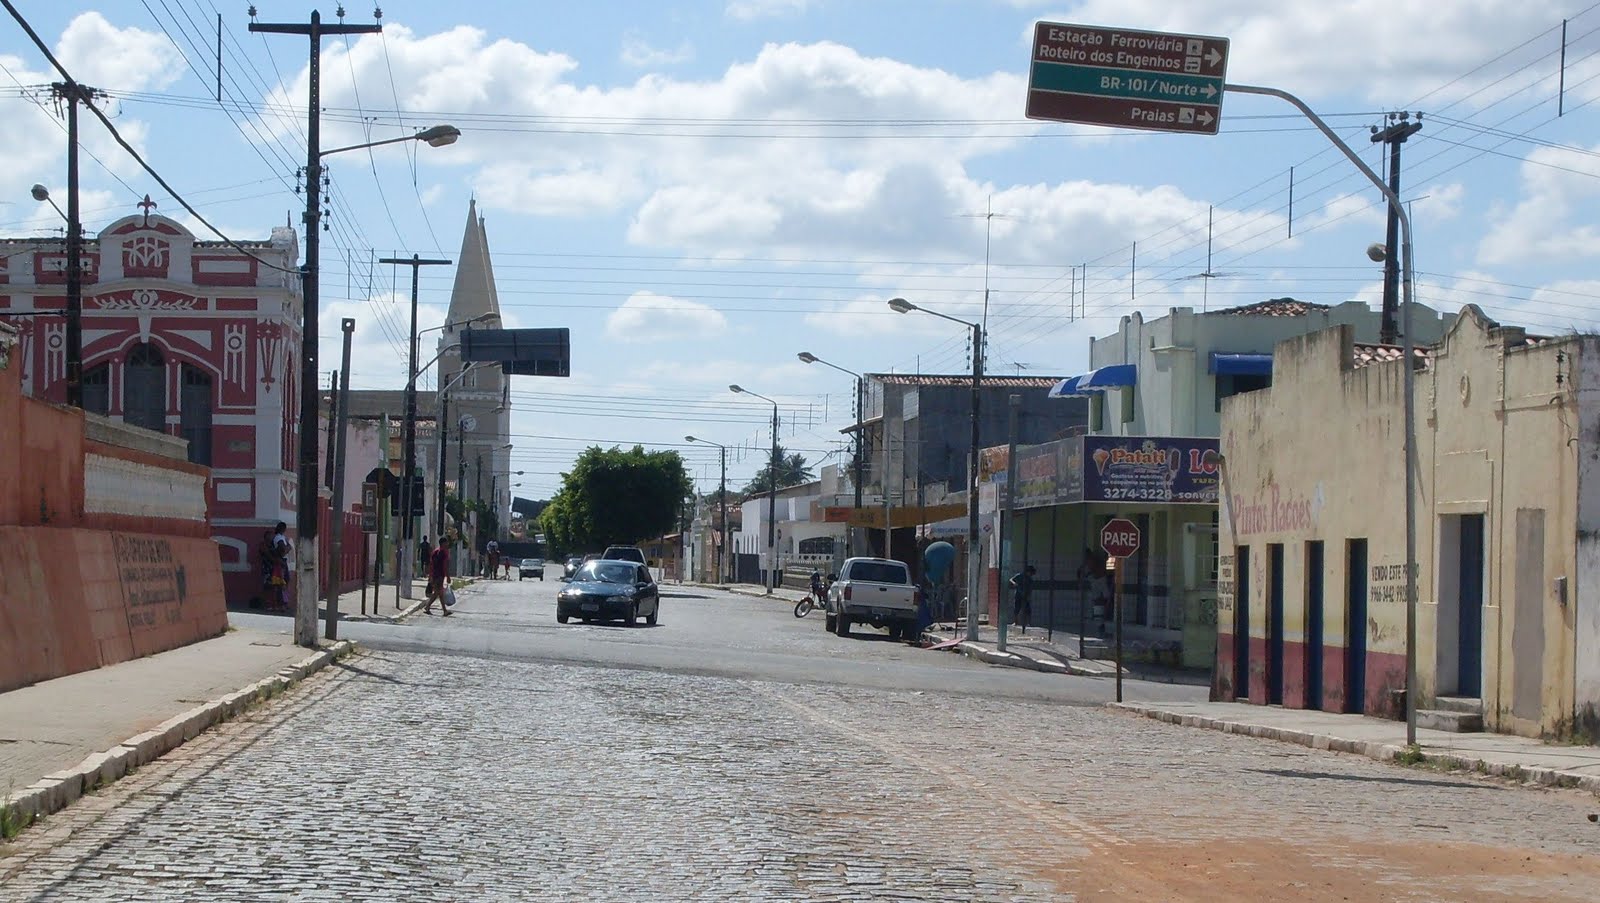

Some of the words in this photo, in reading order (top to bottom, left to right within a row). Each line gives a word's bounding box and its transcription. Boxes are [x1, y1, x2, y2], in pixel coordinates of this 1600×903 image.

[1049, 28, 1103, 46] Estação
[1111, 33, 1183, 52] Ferroviária
[1039, 44, 1087, 61] Roteiro
[1090, 49, 1114, 63] dos
[1116, 51, 1181, 69] Engenhos
[1131, 107, 1175, 123] Praias
[1111, 448, 1166, 464] Patati
[1189, 448, 1219, 474] LO
[1103, 488, 1172, 500] 3274-3228
[1104, 532, 1137, 547] PARE
[1371, 566, 1388, 582] VENDO
[1389, 564, 1402, 580] ESTE
